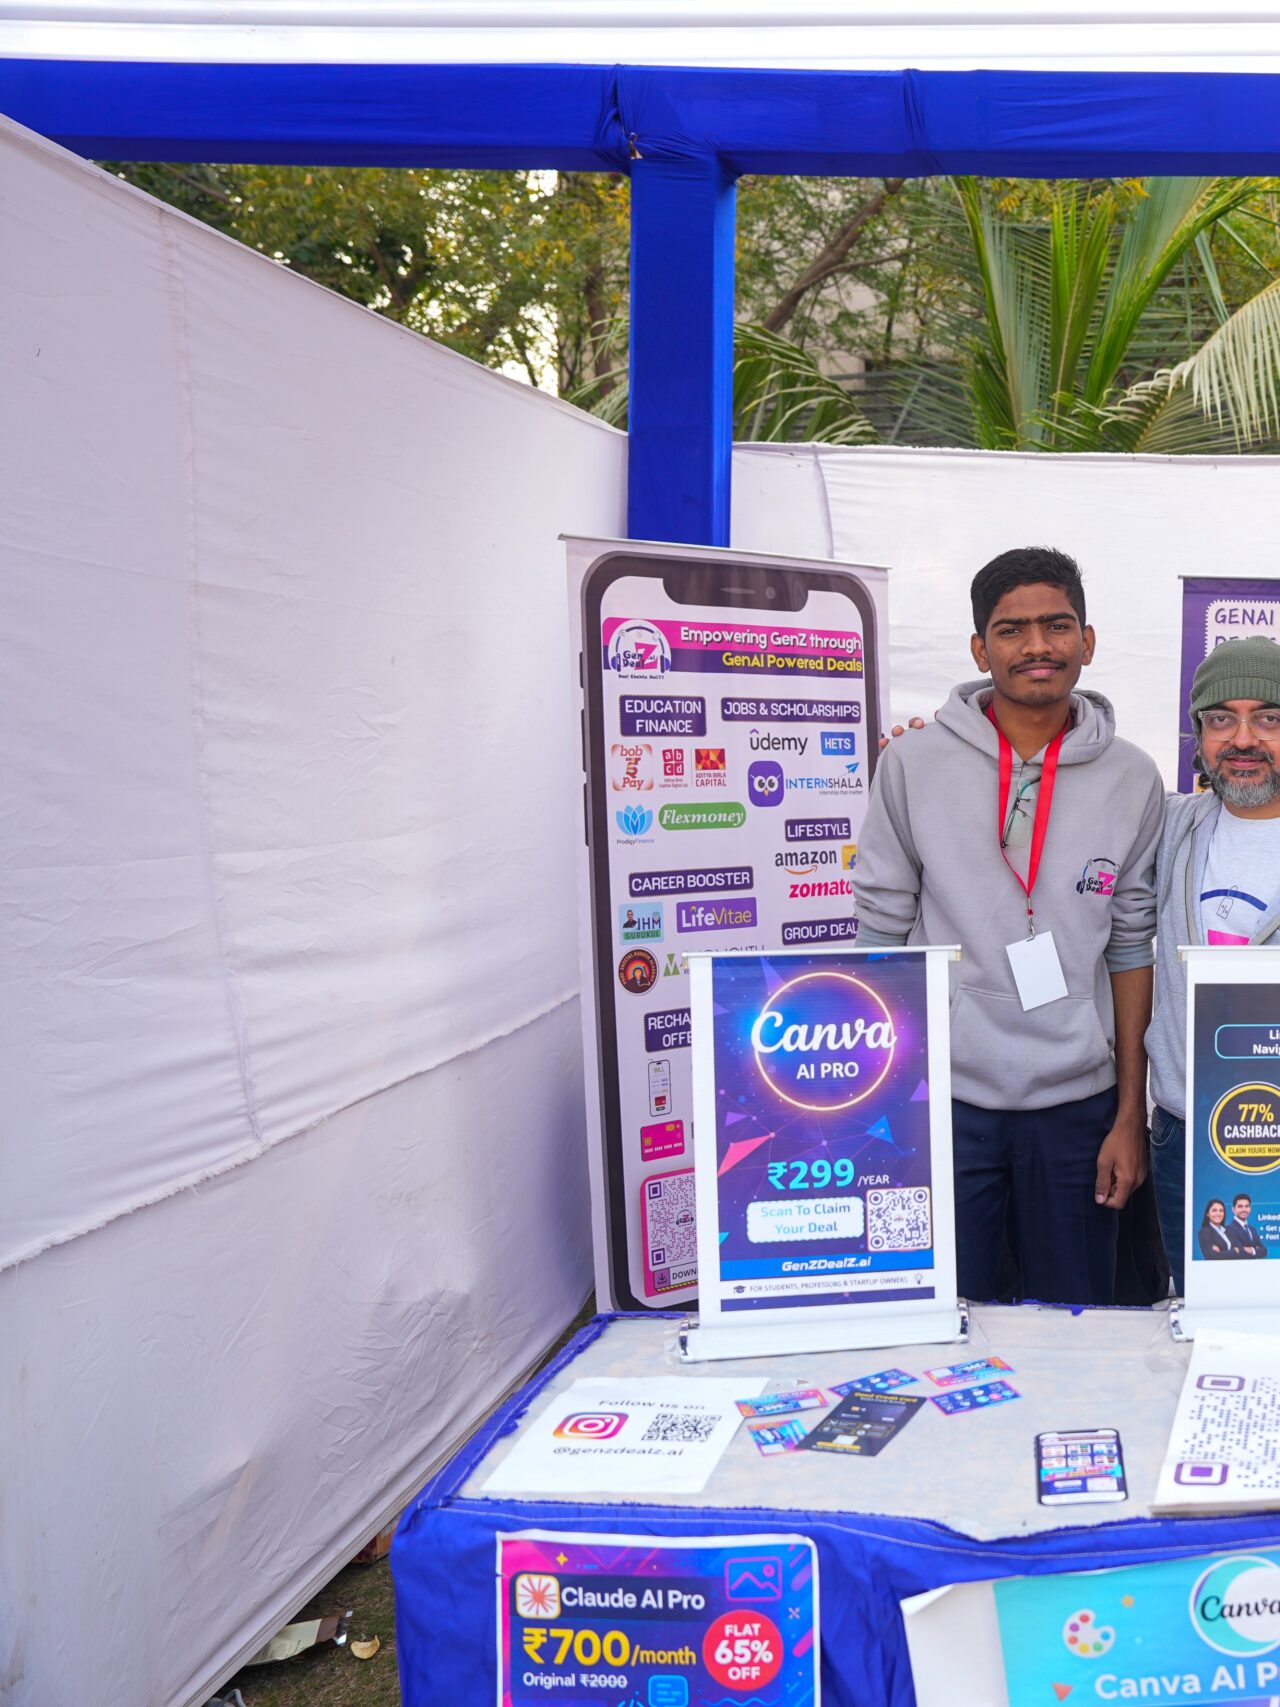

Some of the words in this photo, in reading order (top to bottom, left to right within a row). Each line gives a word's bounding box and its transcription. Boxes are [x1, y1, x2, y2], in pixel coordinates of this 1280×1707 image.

[1215, 608, 1274, 625] GENAI
[681, 626, 768, 649] Empowering
[771, 627, 807, 647] GenZ
[810, 633, 862, 654] through
[723, 653, 764, 669] GenAI
[767, 654, 824, 671] Powered
[827, 657, 863, 672] Deals
[625, 700, 701, 714] EDUCATION
[724, 702, 757, 716] JOBS
[759, 704, 768, 716] &
[770, 703, 860, 718] SCHOLARSHIPS
[636, 719, 693, 733] FINANCE
[620, 745, 643, 757] bob
[824, 738, 851, 750] HETS
[622, 777, 644, 791] Pay
[696, 779, 727, 787] CAPITAL
[786, 778, 863, 790] INTERNSHALA
[661, 808, 744, 827] Flexmoney
[787, 823, 849, 837] LIFESTYLE
[775, 849, 837, 867] amazon
[631, 876, 684, 892] CAREER
[688, 871, 750, 888] BOOSTER
[681, 906, 752, 928] LifeVitae
[784, 925, 826, 940] GROUP
[751, 1011, 897, 1054] Canva
[796, 1063, 815, 1080] AI
[821, 1061, 859, 1079] PRO
[1238, 1104, 1274, 1122] 77%
[1228, 1146, 1246, 1154] CLAIM
[767, 1158, 855, 1190] ₹299
[857, 1174, 890, 1187] /YEAR
[761, 1207, 793, 1218] Scan
[795, 1205, 811, 1216] To
[814, 1203, 851, 1215] Claim
[775, 1223, 804, 1235] Your
[807, 1222, 838, 1233] Deal
[782, 1256, 872, 1272] GenZDealZ.ai
[599, 1399, 655, 1407] Follow
[553, 1446, 684, 1457] @genzdealz.ai
[561, 1587, 637, 1609] Claude
[640, 1589, 663, 1609] AI
[668, 1590, 705, 1610] Pro
[724, 1623, 760, 1637] FLAT
[522, 1627, 630, 1667] ₹700
[630, 1644, 697, 1667] /month
[714, 1640, 773, 1665] 65%
[523, 1672, 575, 1689] Original
[580, 1674, 629, 1689] ₹2000
[727, 1666, 760, 1681] OFF
[1095, 1670, 1201, 1700] Canva
[1210, 1664, 1246, 1691] AI
